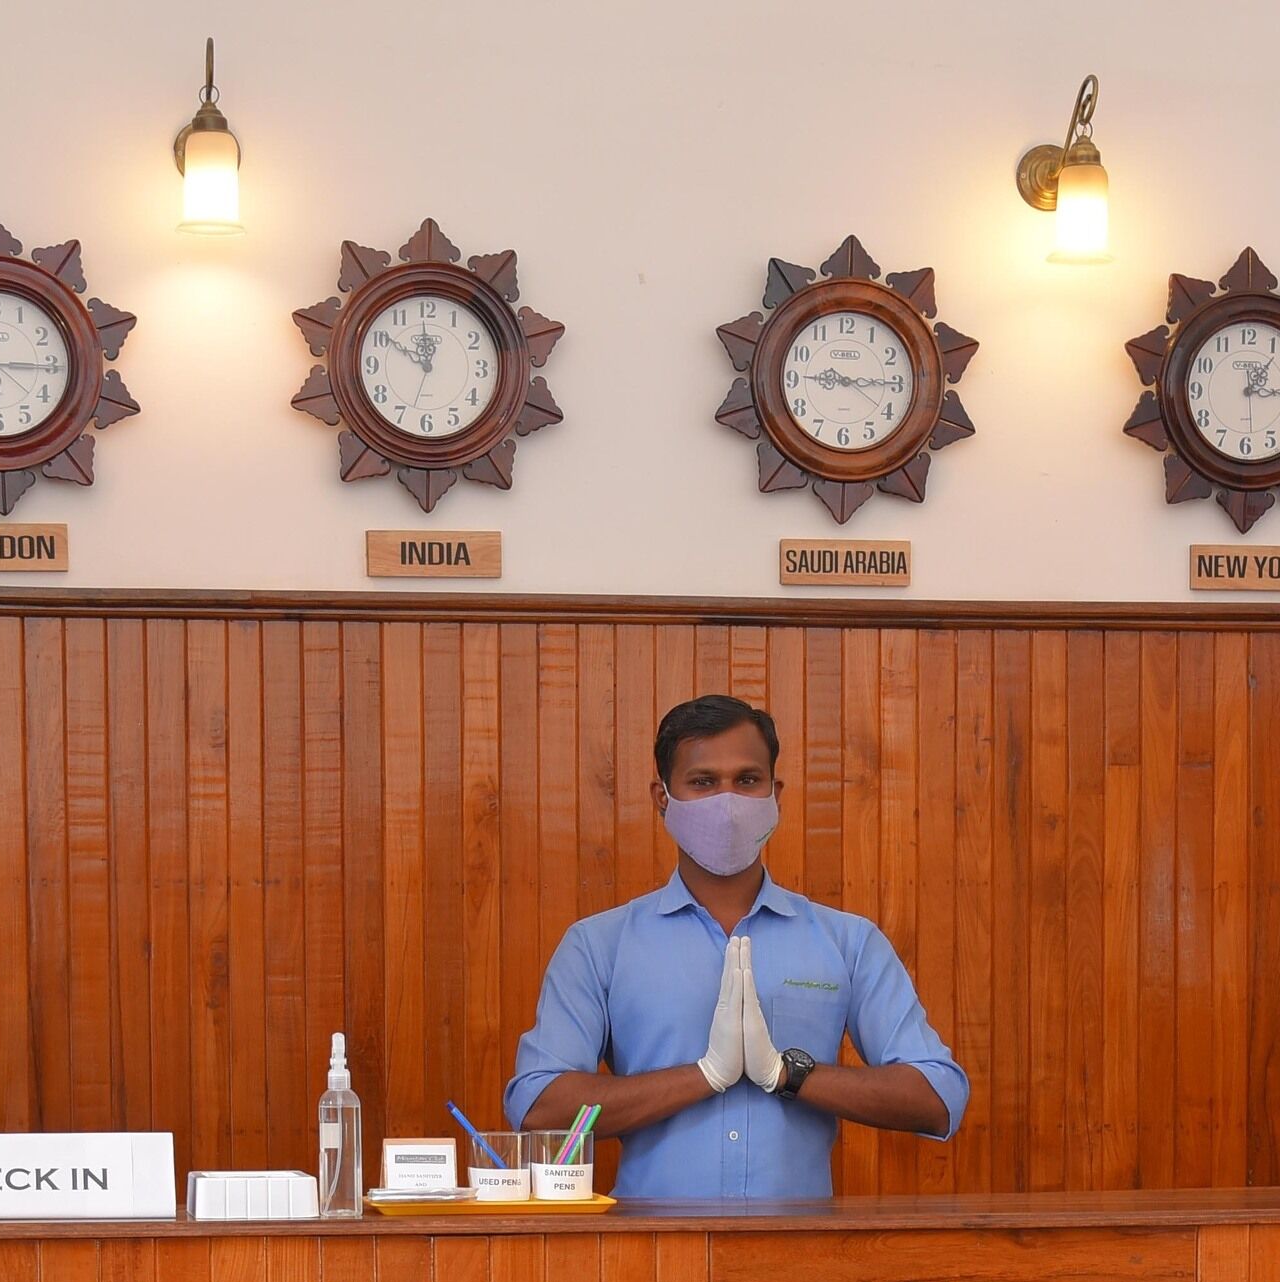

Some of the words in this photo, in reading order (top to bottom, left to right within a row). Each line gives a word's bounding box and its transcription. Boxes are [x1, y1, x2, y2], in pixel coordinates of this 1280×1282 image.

[16, 307, 24, 324] 1
[392, 309, 408, 326] 11
[420, 302, 436, 318] 12
[449, 311, 457, 328] 1
[839, 318, 855, 334] 12
[36, 327, 49, 346] 2
[373, 330, 389, 348] 10
[468, 332, 480, 349] 2
[812, 324, 827, 341] 11
[868, 327, 876, 343] 1
[1241, 329, 1256, 345] 12
[1216, 336, 1229, 352] 11
[1270, 337, 1276, 354] 1
[794, 346, 809, 362] 10
[884, 348, 896, 365] 2
[45, 356, 59, 374] 3
[366, 356, 379, 375] 9
[475, 360, 488, 378] 3
[1198, 358, 1212, 373] 10
[786, 370, 799, 388] 9
[891, 375, 904, 393] 3
[36, 384, 51, 402] 4
[374, 384, 387, 403] 8
[466, 388, 479, 406] 4
[1190, 382, 1202, 399] 9
[19, 406, 31, 424] 5
[394, 406, 407, 424] 7
[793, 399, 806, 416] 8
[881, 402, 894, 420] 4
[420, 414, 433, 432] 6
[448, 408, 459, 426] 5
[1198, 409, 1209, 428] 8
[813, 419, 824, 437] 7
[838, 428, 849, 446] 6
[863, 422, 875, 439] 5
[1216, 429, 1227, 447] 7
[1239, 438, 1251, 455] 6
[1265, 431, 1276, 449] 5
[400, 542, 471, 565] INDIA
[785, 549, 838, 574] SAUDI
[843, 550, 907, 575] ARABIA
[1197, 555, 1247, 579] NEW
[71, 1168, 108, 1190] IN
[544, 1168, 585, 1177] SANITIZED
[478, 1178, 499, 1186] USED
